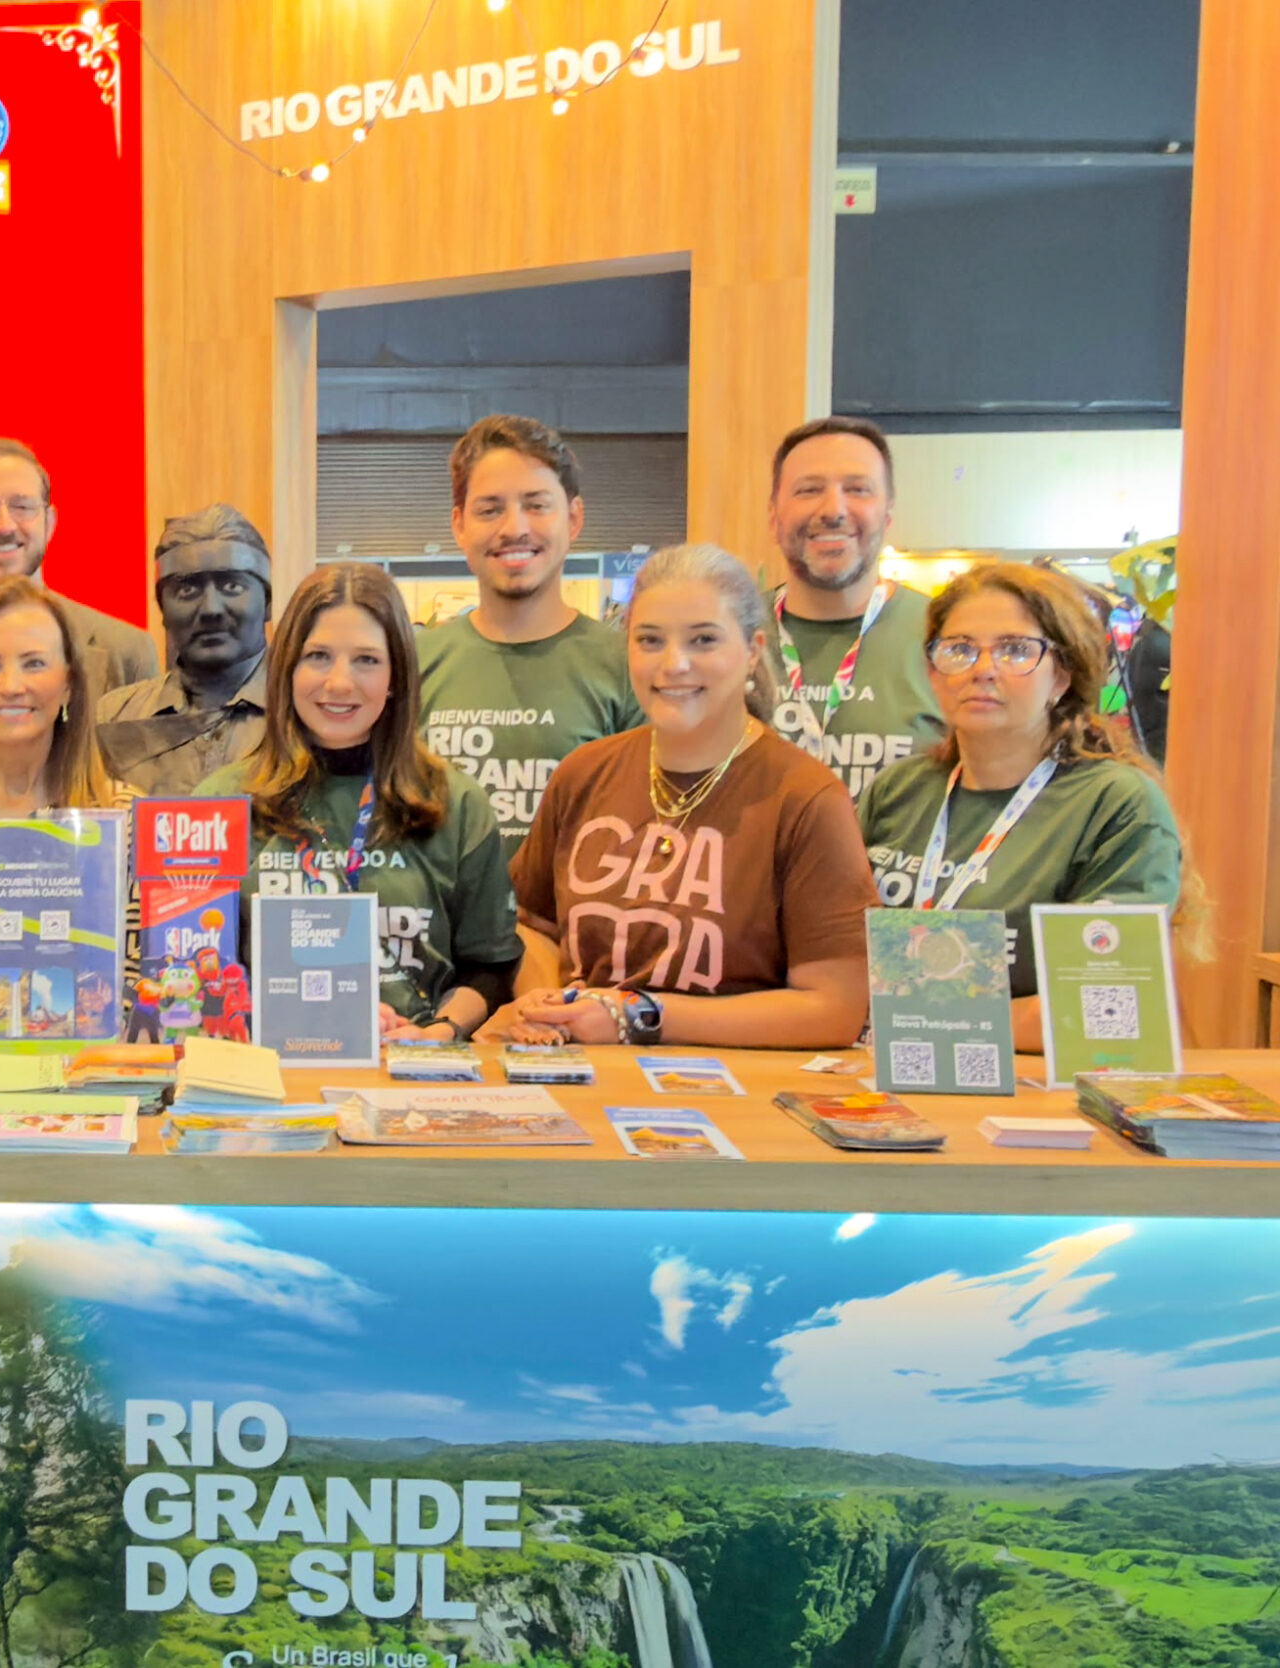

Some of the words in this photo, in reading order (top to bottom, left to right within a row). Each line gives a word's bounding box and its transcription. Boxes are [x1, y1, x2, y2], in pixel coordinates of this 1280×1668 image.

[240, 91, 320, 141] RIO
[324, 55, 537, 127] GRANDE
[544, 41, 621, 94] DO
[629, 21, 740, 78] SUL
[858, 686, 874, 701] A
[429, 709, 537, 726] BIENVENIDO
[540, 709, 555, 726] A
[428, 726, 494, 757] RIO
[489, 790, 544, 823] SU
[176, 812, 229, 852] Park
[389, 852, 406, 868] A
[567, 815, 725, 915] GRA
[8, 888, 41, 897] SIERRA
[35, 878, 48, 887] TU
[48, 877, 81, 887] LUGAR
[291, 920, 312, 930] RIO
[291, 929, 340, 939] GRANDE
[182, 928, 220, 957] Park
[291, 939, 308, 948] DO
[311, 939, 335, 948] SUL
[892, 1020, 920, 1029] Nova
[125, 1399, 288, 1468] RIO
[122, 1472, 521, 1548] GRANDE
[125, 1545, 258, 1614] DO
[287, 1550, 477, 1620] SUL
[272, 1645, 304, 1665] Un
[312, 1645, 377, 1667] Brasil
[384, 1652, 428, 1668] que
